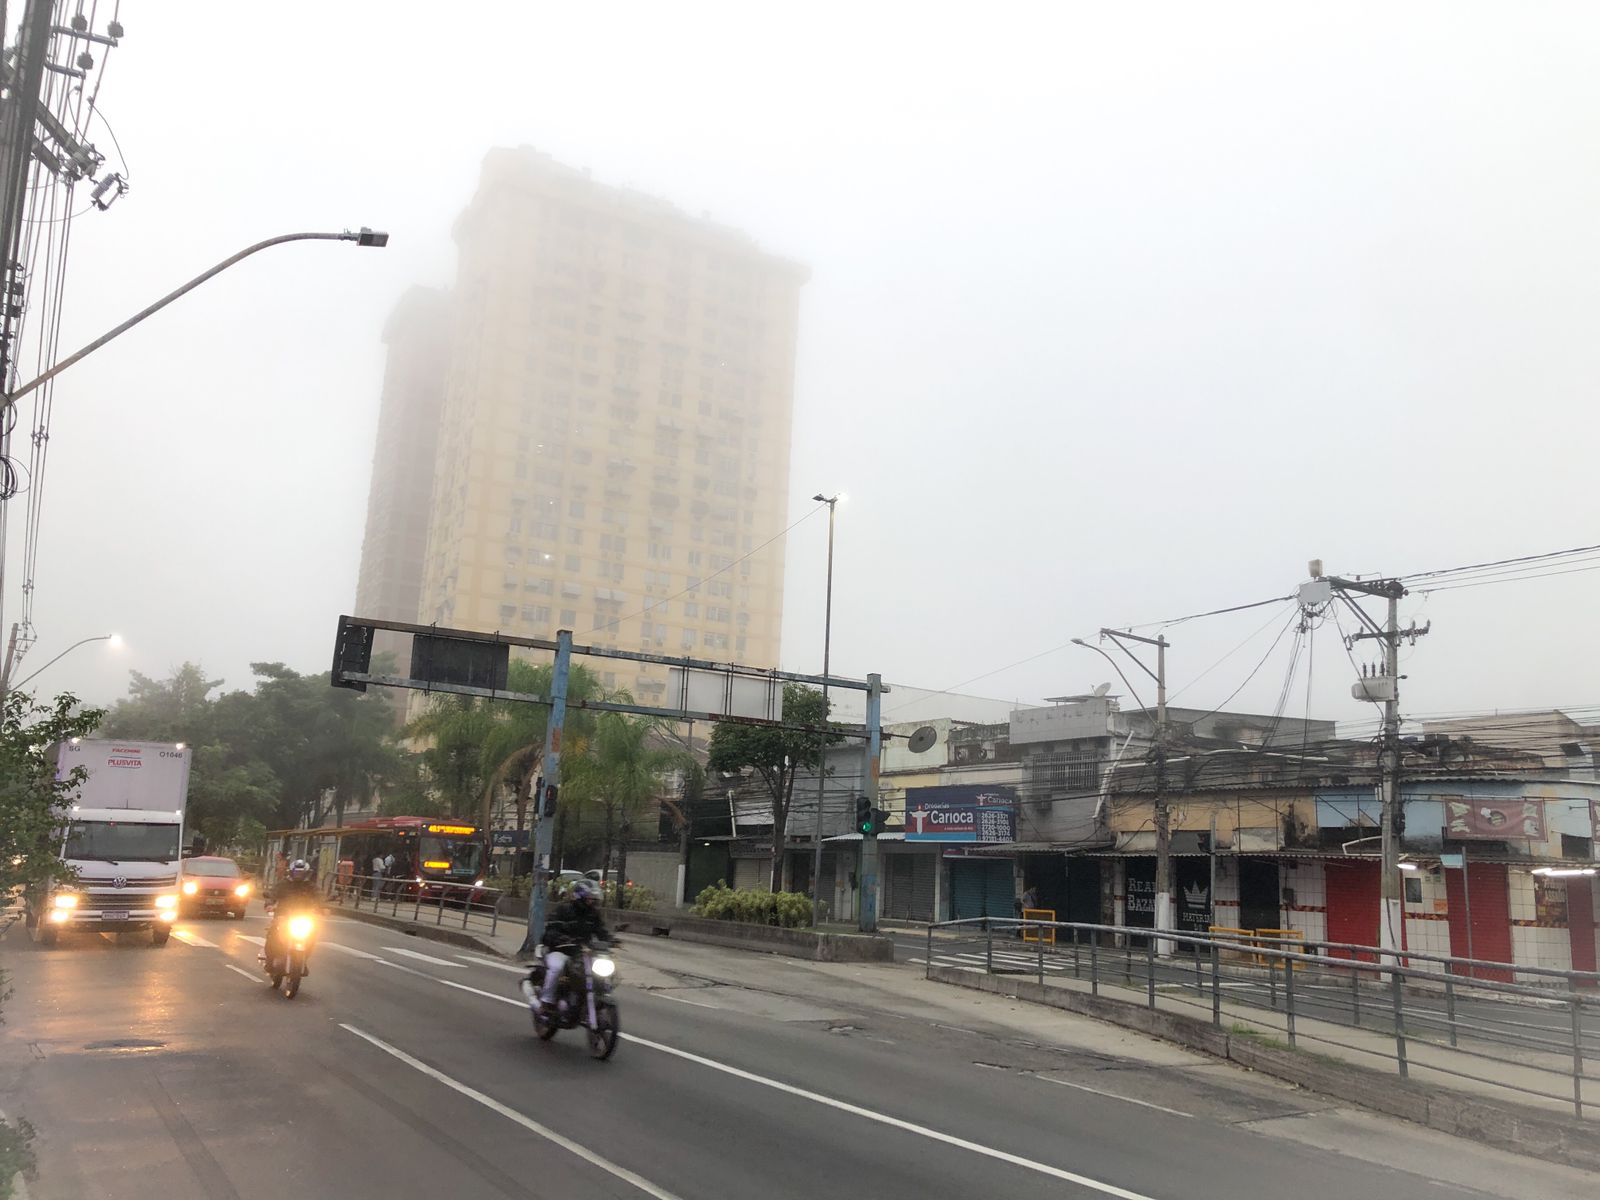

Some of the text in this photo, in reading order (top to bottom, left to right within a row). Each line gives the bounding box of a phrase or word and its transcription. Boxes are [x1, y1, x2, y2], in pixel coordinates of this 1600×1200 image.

[107, 759, 142, 767] PLUSVITA
[930, 810, 974, 824] Carioca
[1127, 894, 1155, 912] BAZA
